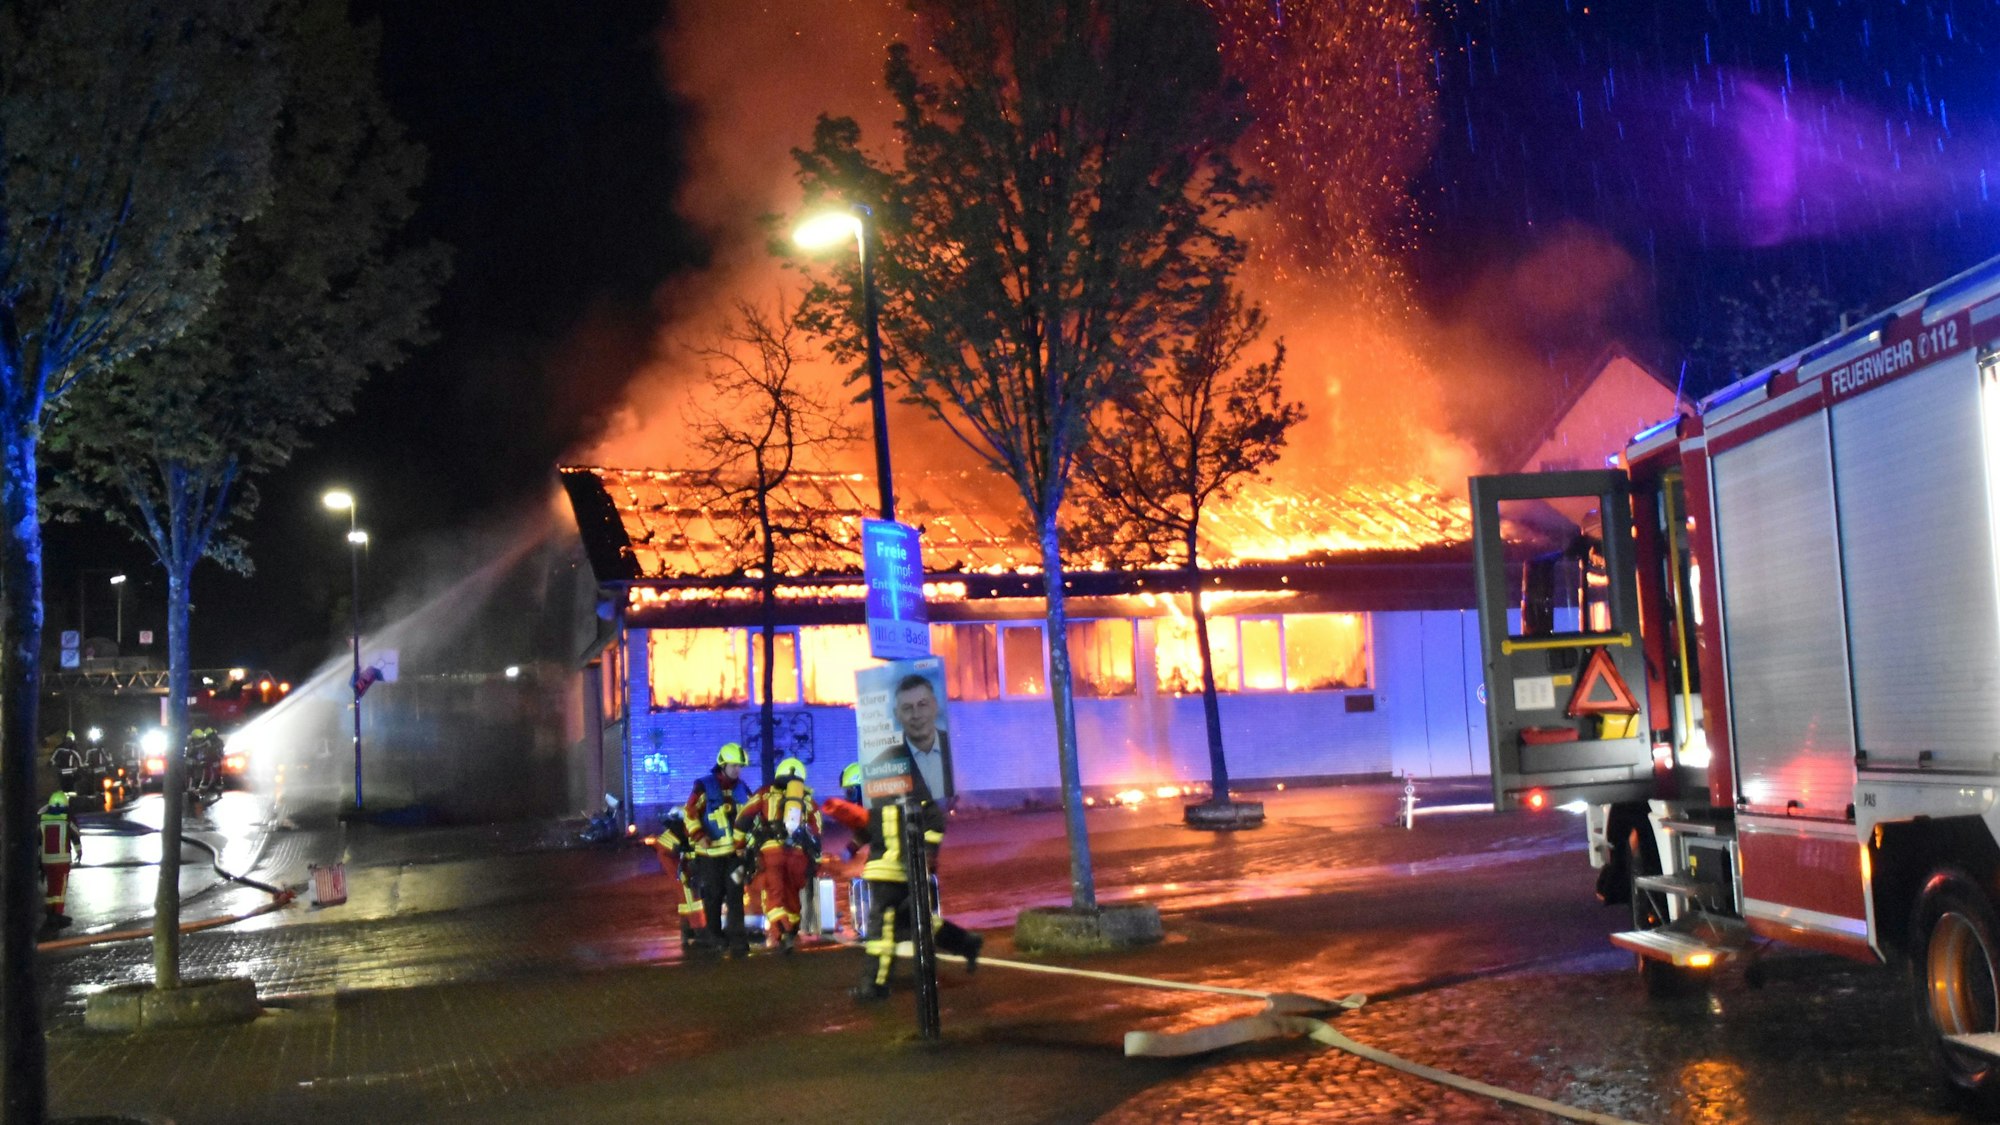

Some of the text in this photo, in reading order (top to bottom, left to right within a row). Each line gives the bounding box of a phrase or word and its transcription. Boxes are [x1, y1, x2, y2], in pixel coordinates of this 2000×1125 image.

[1831, 320, 1959, 397] FEUERWEHR 112
[876, 541, 907, 560] Freie
[872, 578, 922, 599] Entheidung
[863, 735, 900, 749] Heimat.
[865, 761, 907, 775] Landtag:
